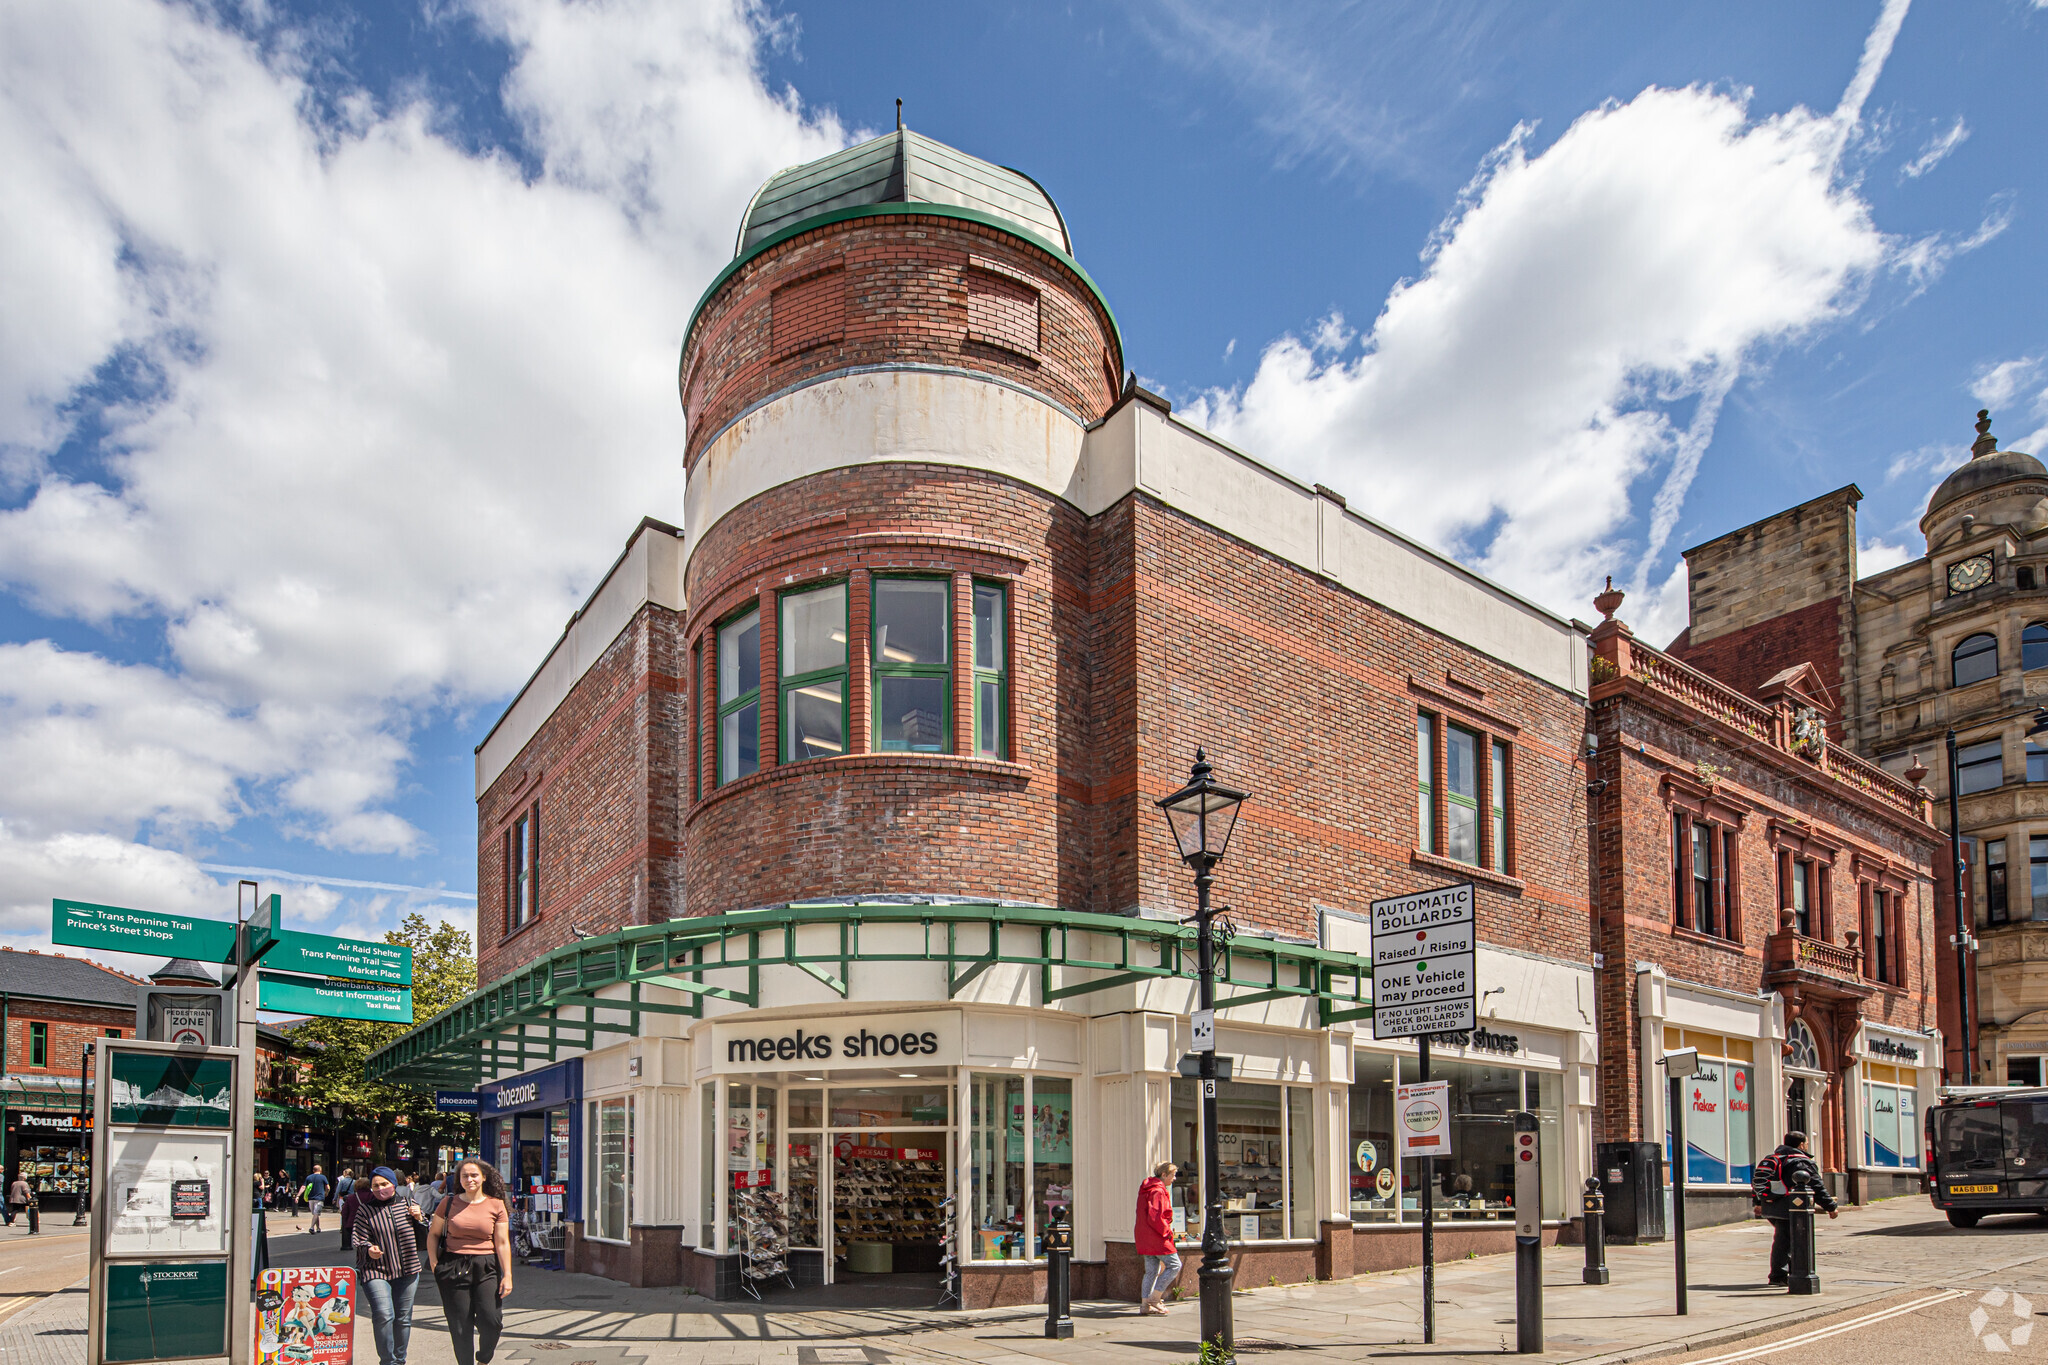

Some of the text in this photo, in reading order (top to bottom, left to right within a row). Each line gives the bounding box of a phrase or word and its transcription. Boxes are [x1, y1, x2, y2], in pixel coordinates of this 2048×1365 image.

[1377, 891, 1467, 917] AUTOMATIC
[97, 911, 192, 931] Trans Pennine Trail
[1382, 906, 1462, 930] BOLLARDS
[67, 919, 174, 940] Prince's Street Shops
[301, 948, 324, 959] Trans
[326, 952, 360, 963] Pennine
[362, 956, 380, 966] Trail
[337, 943, 401, 959] Air Raid Shelter
[1379, 940, 1467, 960] Raised / Rising
[348, 966, 401, 979] Market Place
[1381, 969, 1465, 989] ONE Vehicle
[324, 979, 401, 994] Underbanks Shops
[1382, 982, 1465, 1002] may proceed
[314, 988, 344, 998] Tourist
[345, 990, 395, 1002] Information
[366, 1001, 401, 1011] Taxi Rank
[1378, 1002, 1469, 1019] IF NO LIGHT SHOWS
[172, 1017, 204, 1026] ZONE
[1383, 1011, 1465, 1026] CHECK BOLLARDS
[1391, 1020, 1456, 1034] ARE LOWERED
[728, 1029, 938, 1062] meeks shoes
[1429, 1027, 1519, 1052] eeks shoes
[497, 1083, 535, 1107] shoezone
[1206, 1083, 1213, 1093] 6
[440, 1097, 477, 1105] shoezone
[1875, 1099, 1893, 1113] Clarks
[501, 1134, 510, 1145] SALE
[873, 1149, 888, 1157] SALE
[262, 1268, 333, 1285] OPEN
